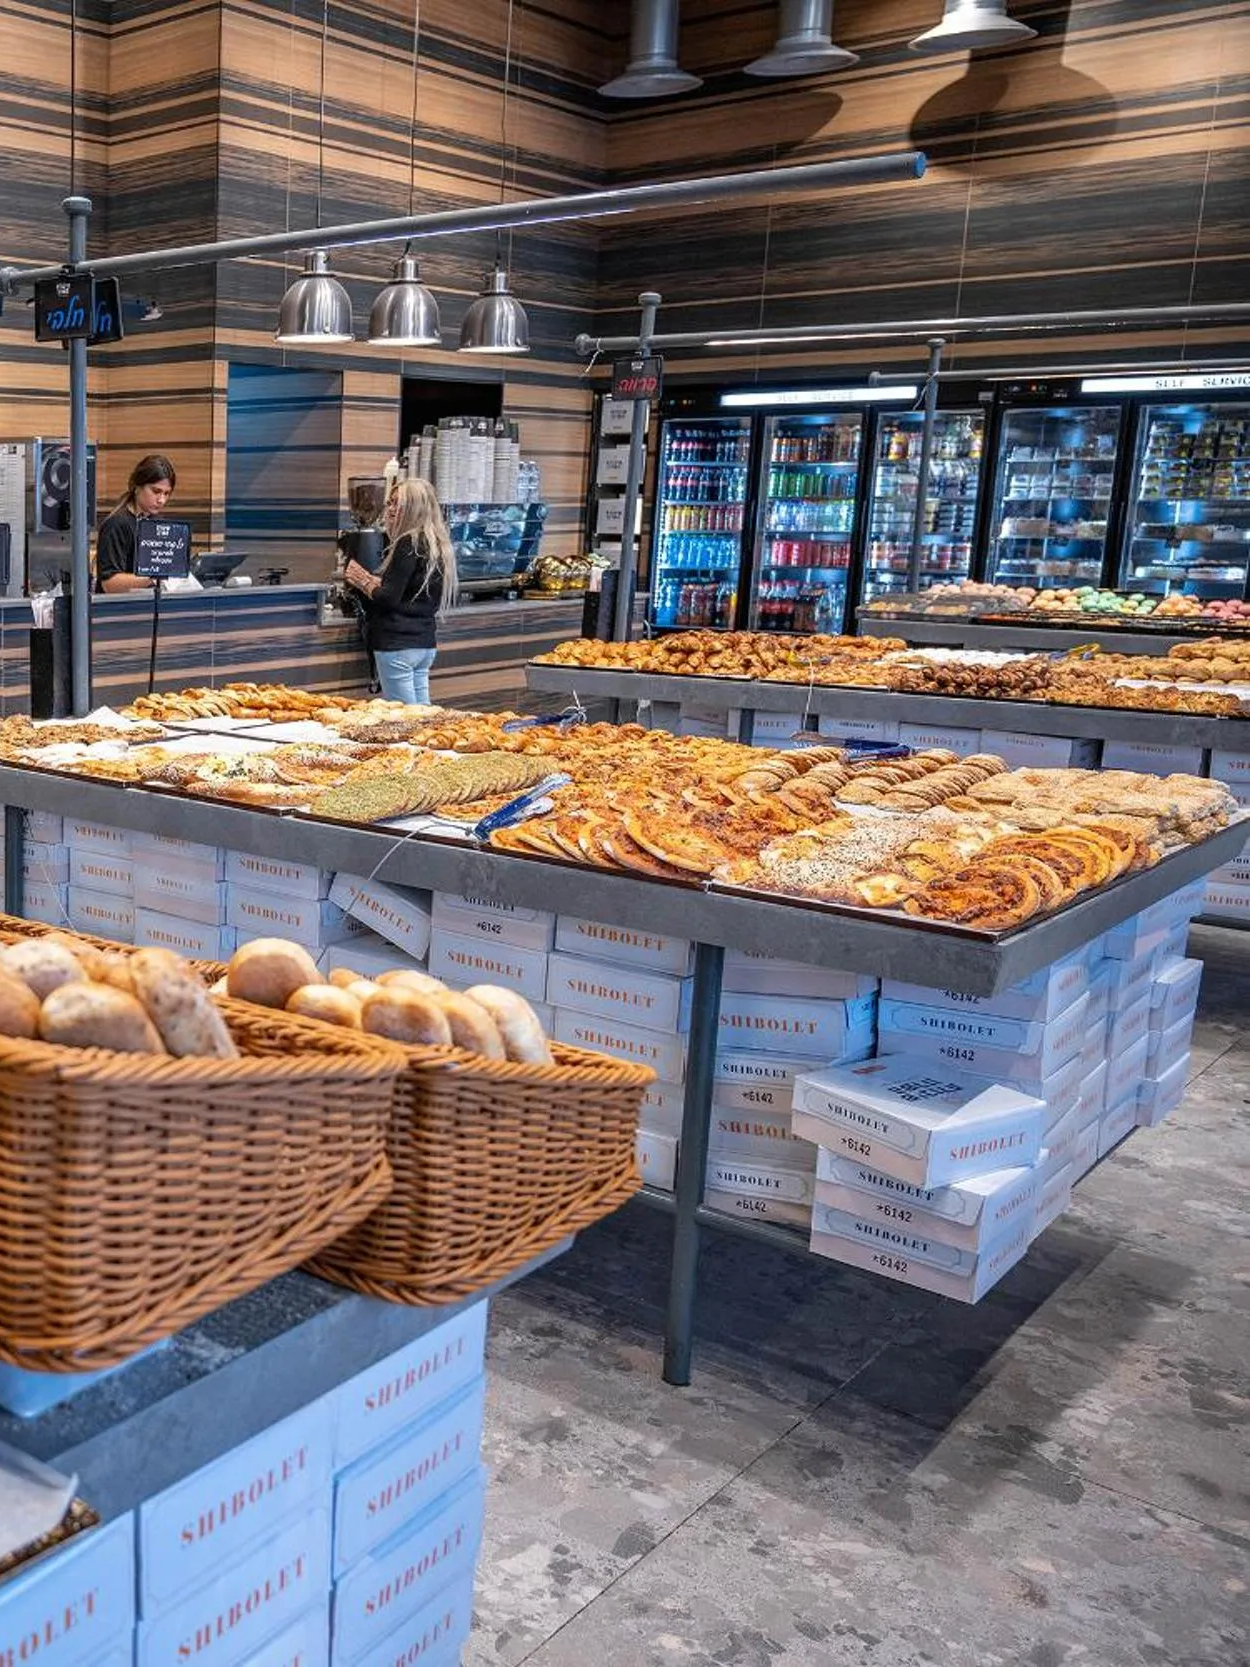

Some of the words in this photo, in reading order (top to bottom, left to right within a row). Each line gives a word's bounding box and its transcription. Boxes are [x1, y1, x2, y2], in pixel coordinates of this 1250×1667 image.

[1203, 377, 1250, 387] SERVIC
[239, 855, 302, 880] SHIBOLET
[240, 902, 302, 927] SHIBOLET
[146, 929, 203, 950] SHIBOLET
[577, 923, 666, 951] SHIBOLET
[448, 951, 524, 979] SHIBOLET
[567, 978, 655, 1008] SHIBOLET
[720, 1012, 818, 1035] SHIBOLET
[921, 1016, 997, 1037] SHIBOLET
[574, 1028, 660, 1058] SHIBOLET
[722, 1063, 788, 1079] SHIBOLET
[717, 1119, 803, 1141] SHIBOL
[827, 1102, 889, 1133] SHIBOLET
[950, 1132, 1026, 1160] SHIBOLET
[716, 1171, 782, 1189] SHIBOLET
[858, 1171, 935, 1201] SHIBOLET
[855, 1223, 931, 1252] SHIBOLET
[365, 1336, 465, 1414] SHIBOLET
[366, 1432, 463, 1518] SHIBOLET
[180, 1446, 308, 1548] SHIBOLET
[365, 1523, 465, 1616] SHIBOLET
[178, 1553, 305, 1664] SHIBOLET
